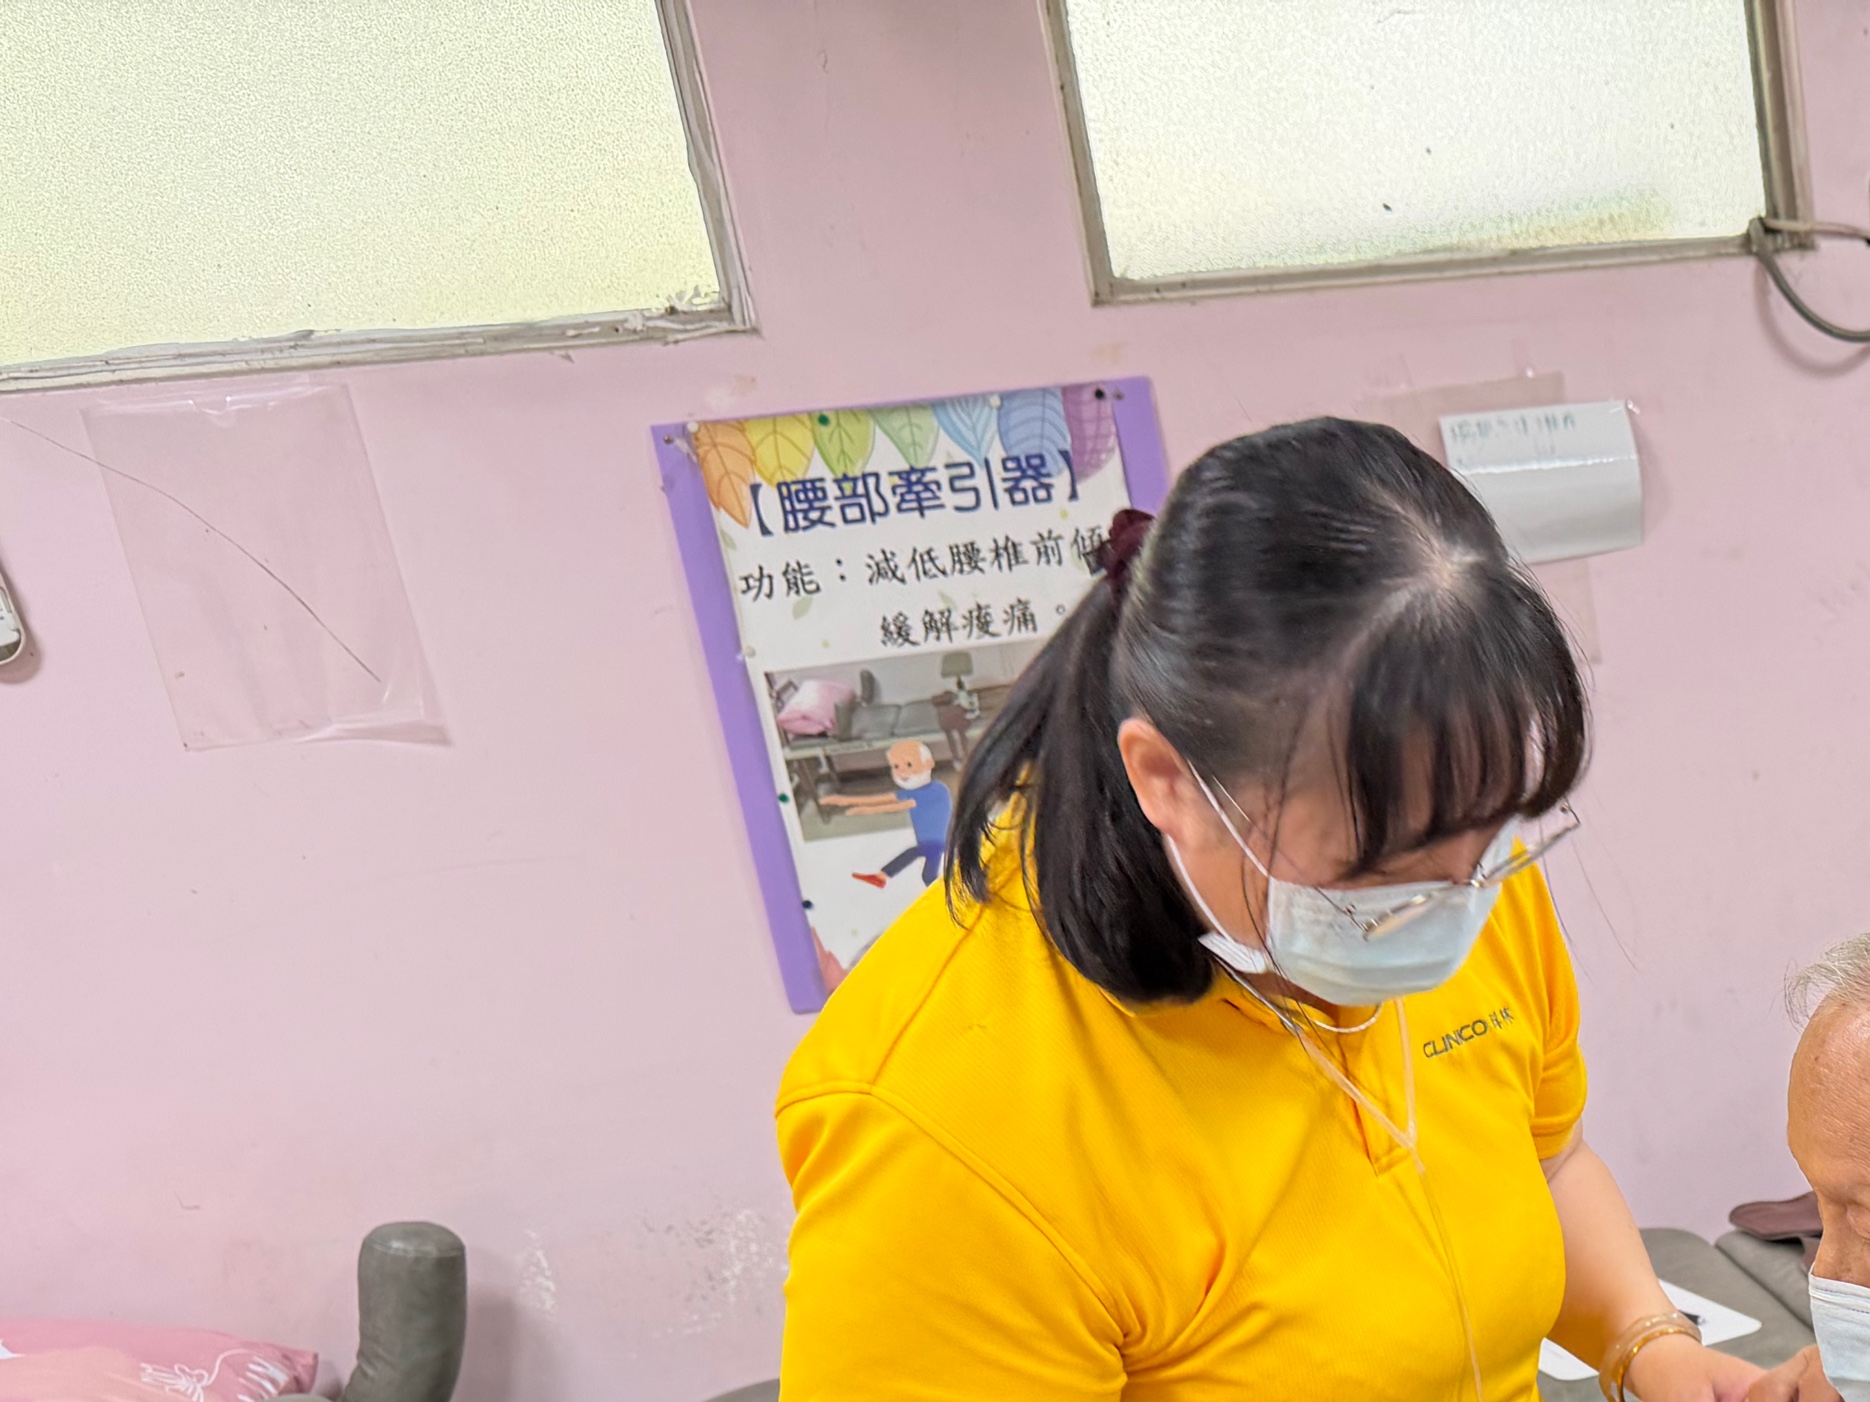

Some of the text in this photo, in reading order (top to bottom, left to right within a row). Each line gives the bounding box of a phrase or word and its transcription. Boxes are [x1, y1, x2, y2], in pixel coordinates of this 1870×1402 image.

[750, 449, 1080, 537] 【腰部牽引器】
